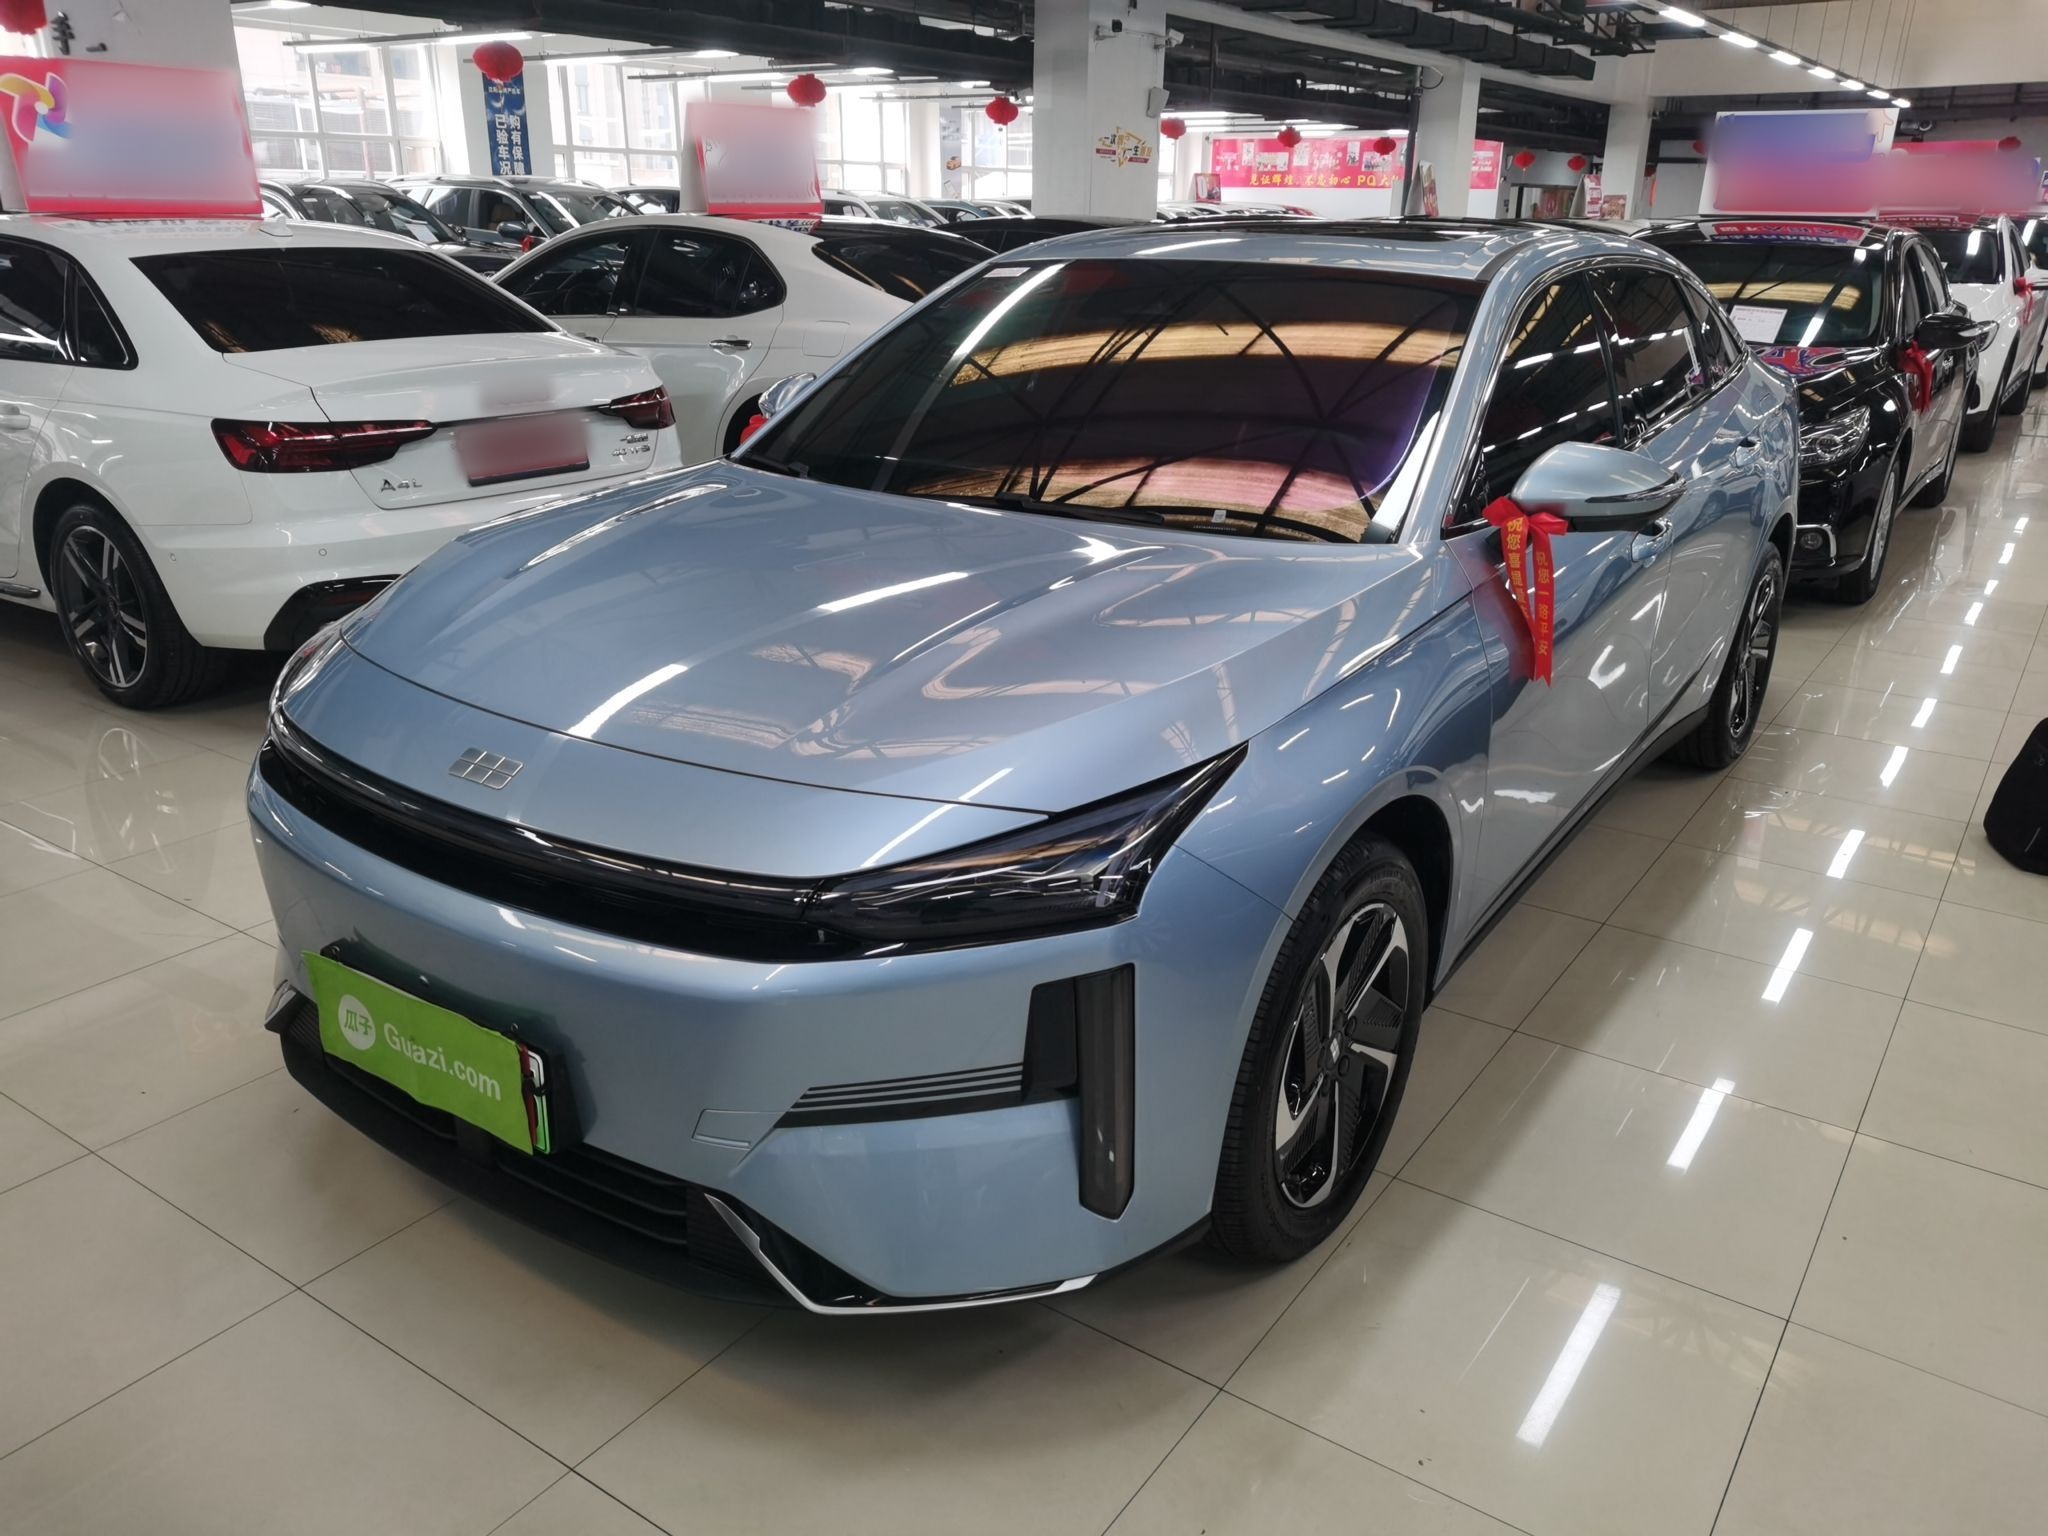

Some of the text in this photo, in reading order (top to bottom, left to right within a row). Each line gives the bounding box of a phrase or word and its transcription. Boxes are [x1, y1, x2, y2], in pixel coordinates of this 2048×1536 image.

[495, 114, 513, 175] 已验车况
[509, 114, 525, 176] 购有保障
[1535, 551, 1552, 656] 祝您一路平安
[343, 1008, 374, 1037] 瓜子
[383, 1022, 502, 1102] Guazi.com
